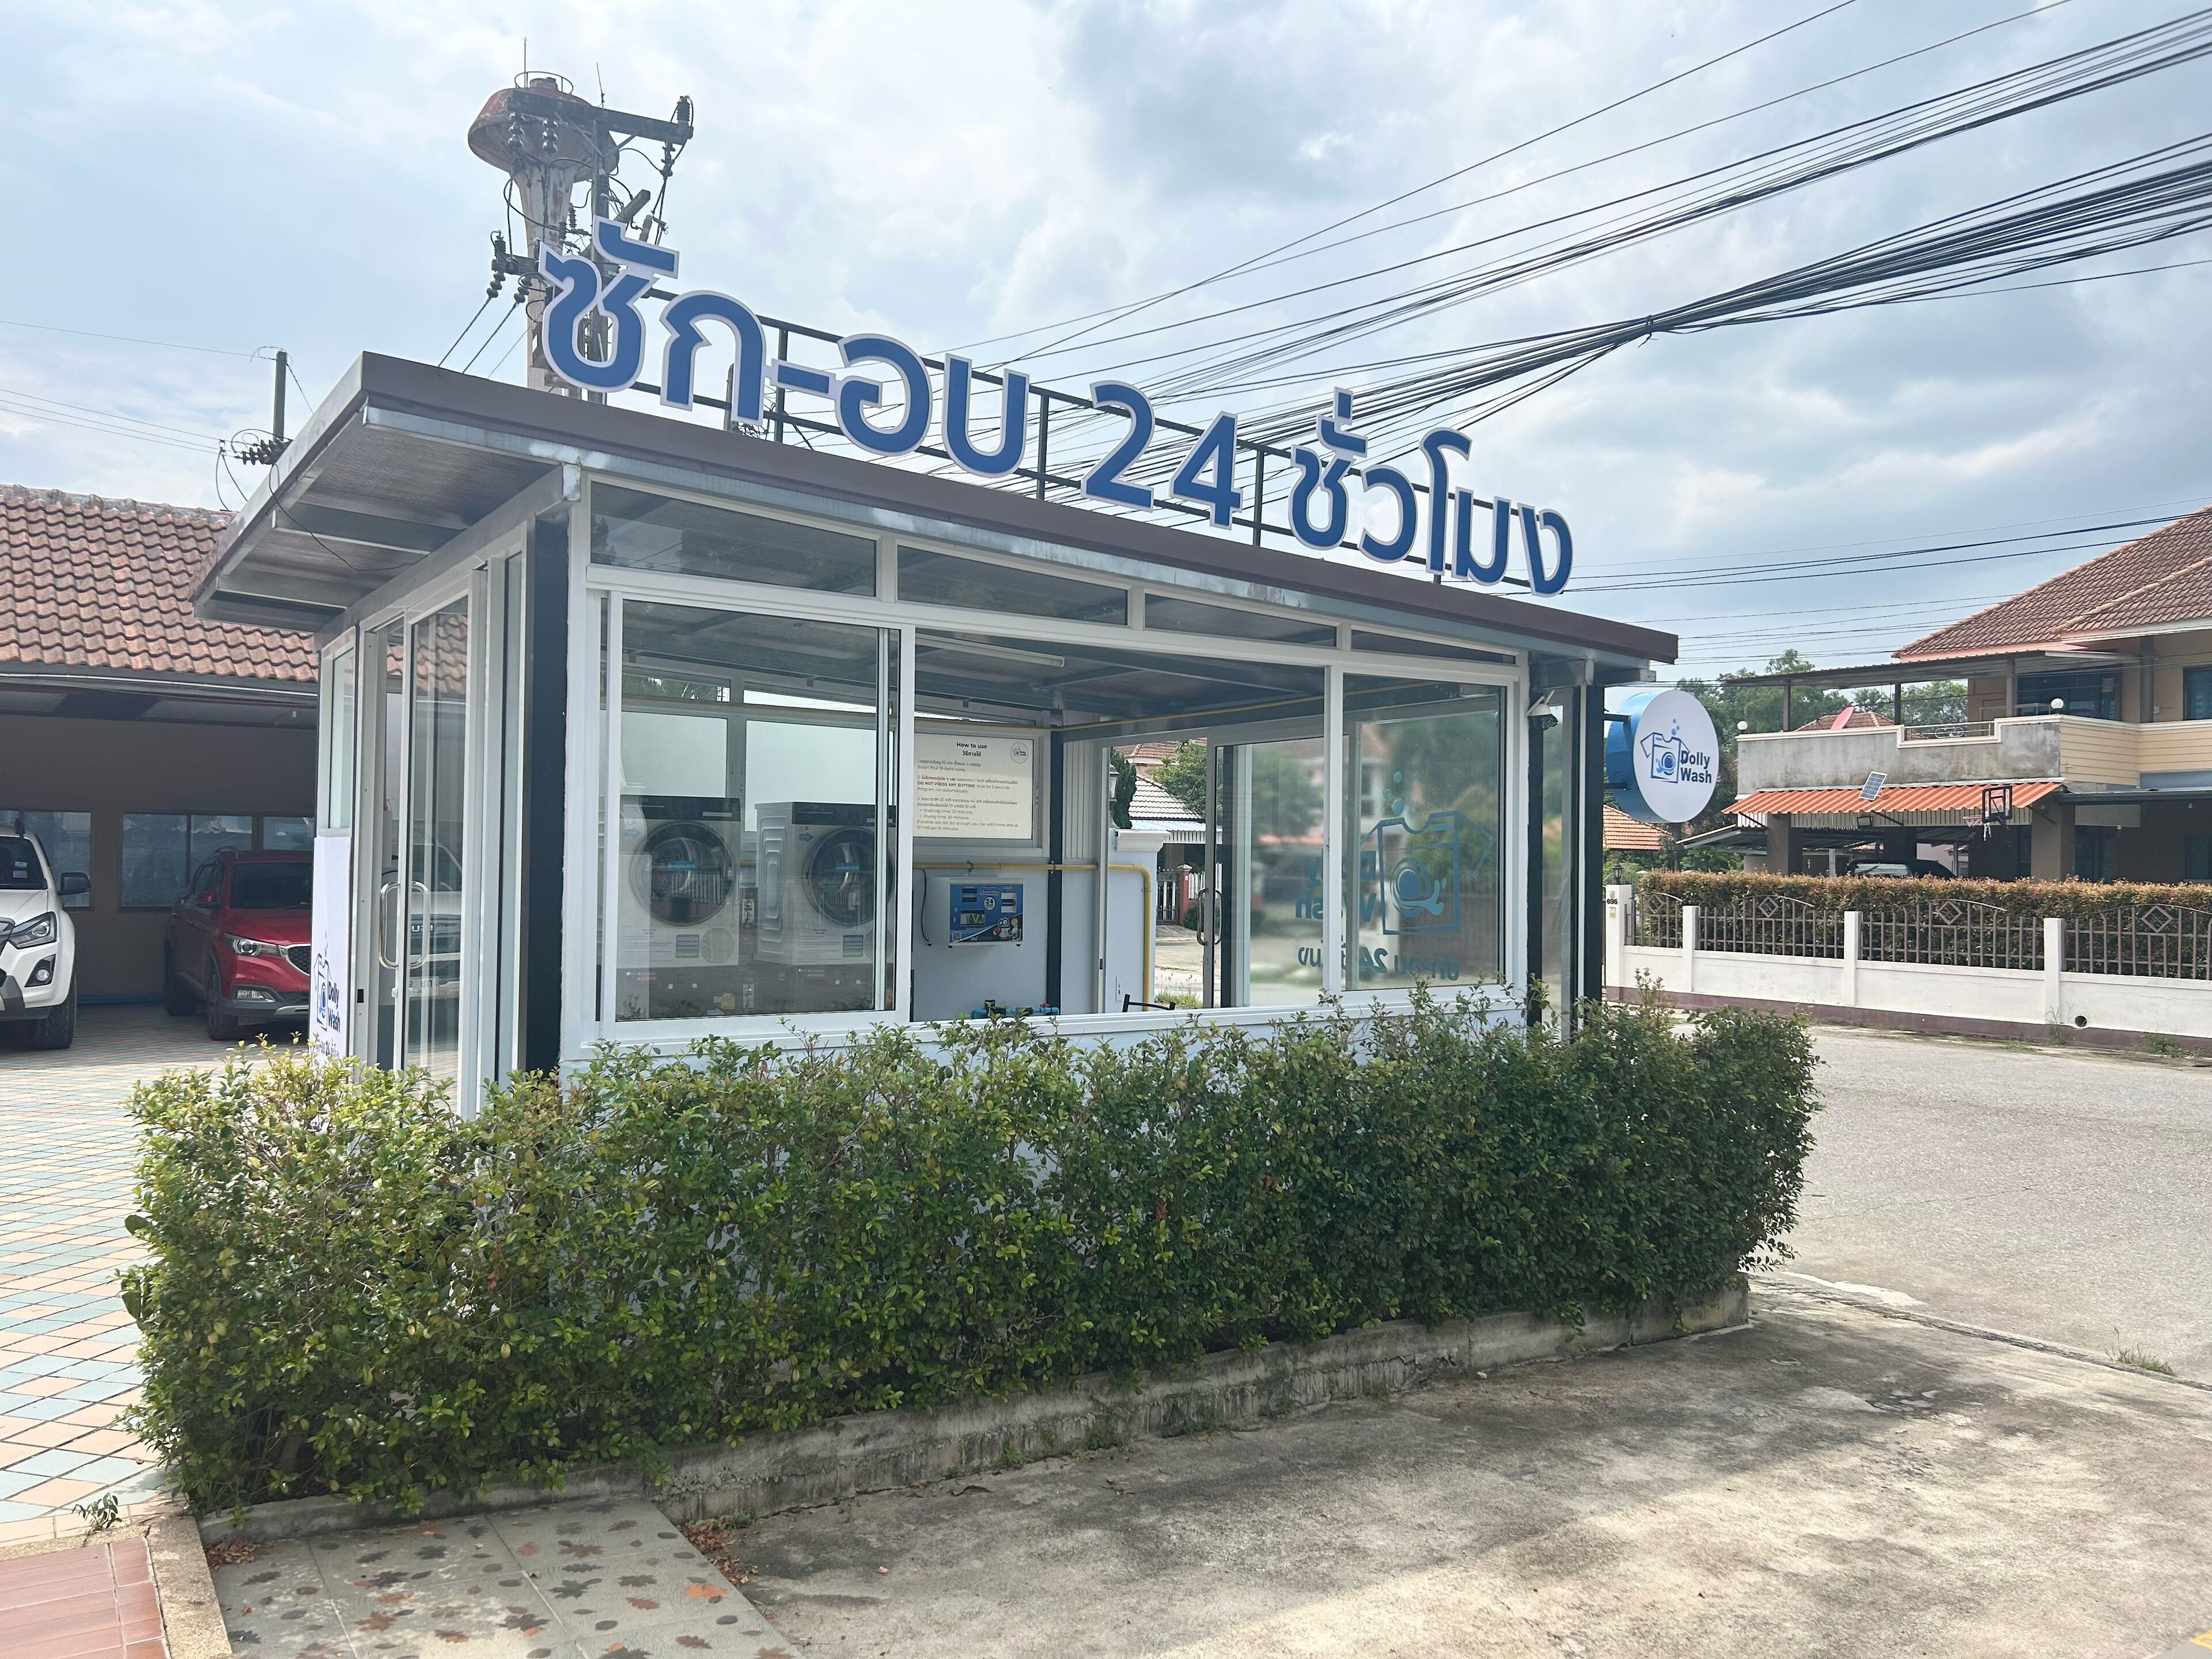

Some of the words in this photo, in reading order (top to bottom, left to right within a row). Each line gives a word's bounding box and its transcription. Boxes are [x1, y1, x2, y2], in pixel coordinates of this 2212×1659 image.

[539, 215, 1030, 478] ซัก-อบ
[1081, 380, 1243, 530] 24
[1287, 387, 1574, 597] ชั่วโมง
[1680, 750, 1710, 770] Dolly
[1680, 767, 1712, 783] Wash
[328, 980, 340, 1009] Dolly
[328, 1007, 340, 1033] Wash
